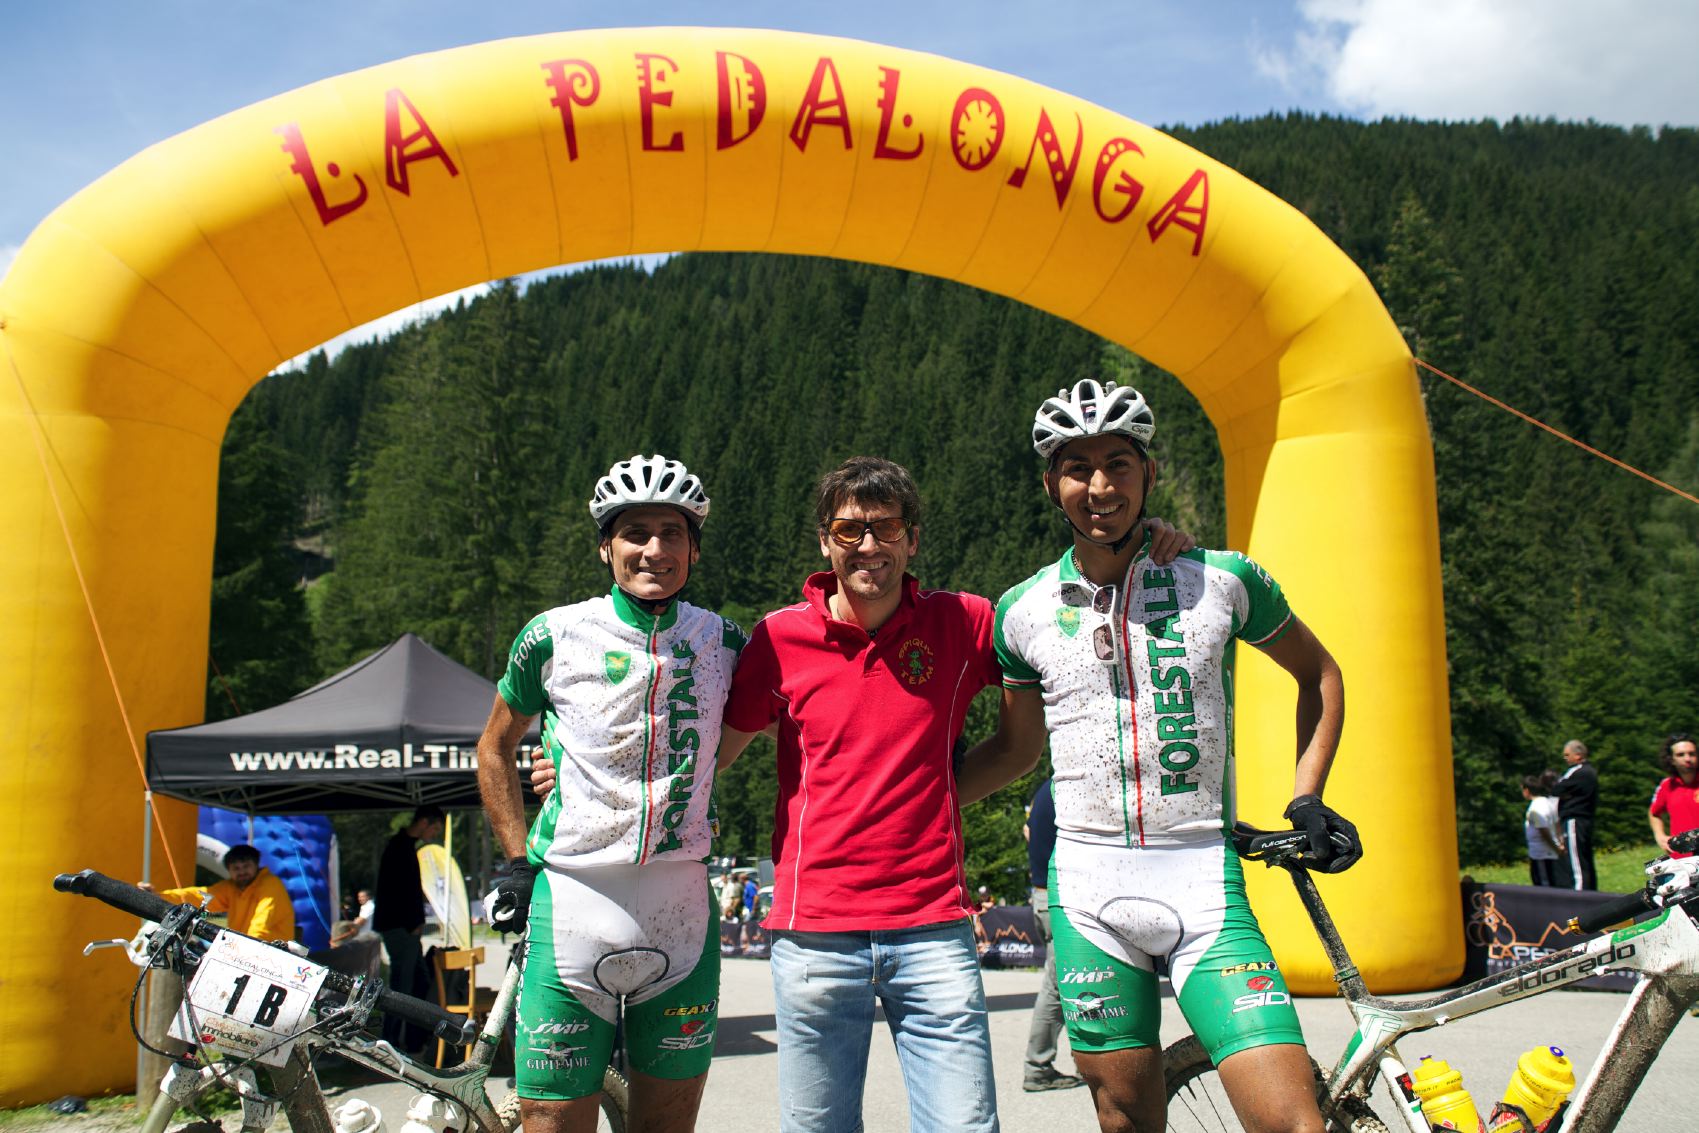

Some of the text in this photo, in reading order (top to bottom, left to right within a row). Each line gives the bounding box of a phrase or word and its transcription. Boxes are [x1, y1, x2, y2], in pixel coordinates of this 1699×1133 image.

[272, 50, 1211, 258] LA PEDALONGA
[1142, 567, 1201, 797] FORESTALE
[656, 639, 700, 854] FORESTALE
[1060, 971, 1116, 984] SMP
[1499, 943, 1636, 997] eldorado
[225, 974, 288, 1028] 1 B
[529, 1023, 590, 1034] SMP
